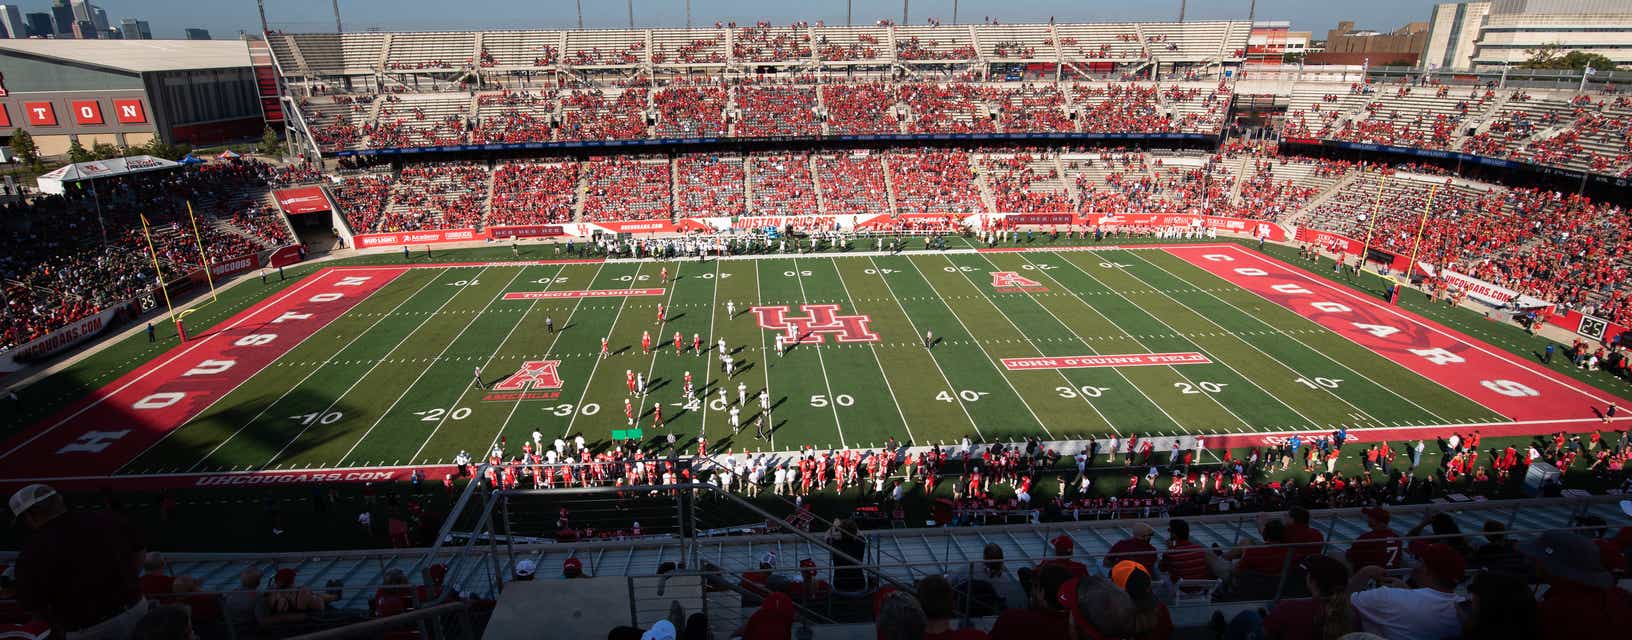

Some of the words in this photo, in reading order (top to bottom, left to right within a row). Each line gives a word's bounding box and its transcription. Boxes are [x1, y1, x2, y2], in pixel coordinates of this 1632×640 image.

[1582, 320, 1603, 336] 25
[1175, 382, 1220, 394] 20
[1296, 377, 1339, 389] 10
[935, 390, 981, 402] 40
[1056, 386, 1103, 398] 30
[810, 395, 854, 406] 50
[421, 408, 472, 421] 20
[553, 404, 600, 416] 30
[303, 412, 343, 425] 10
[196, 472, 394, 486] UHCOUGARS.COM
